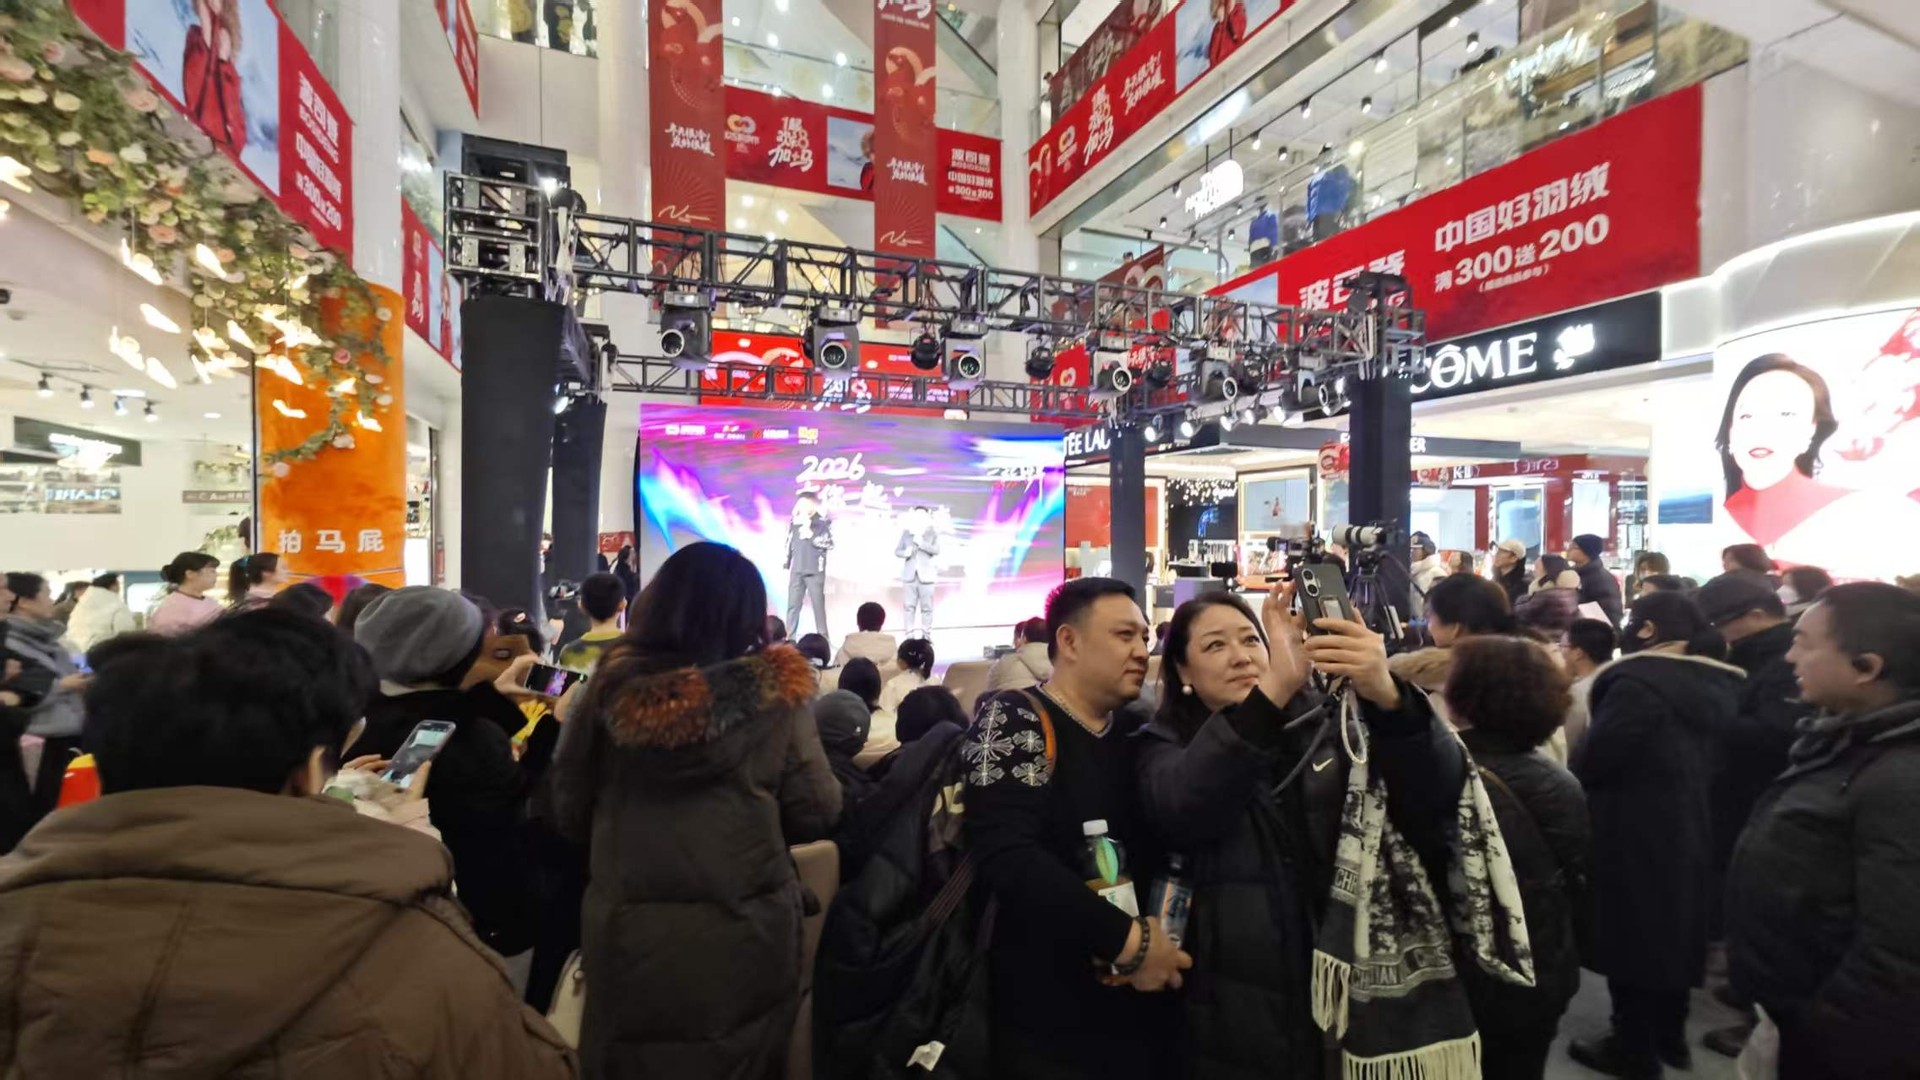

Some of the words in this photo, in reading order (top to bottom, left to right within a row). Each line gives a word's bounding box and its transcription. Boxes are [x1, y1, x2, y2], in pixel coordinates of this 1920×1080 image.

[1434, 161, 1611, 252] 中国好羽绒
[1434, 213, 1610, 292] 满300送200
[1409, 331, 1538, 393] CÔME
[796, 452, 866, 483] 2026
[279, 529, 385, 554] 拍马屁
